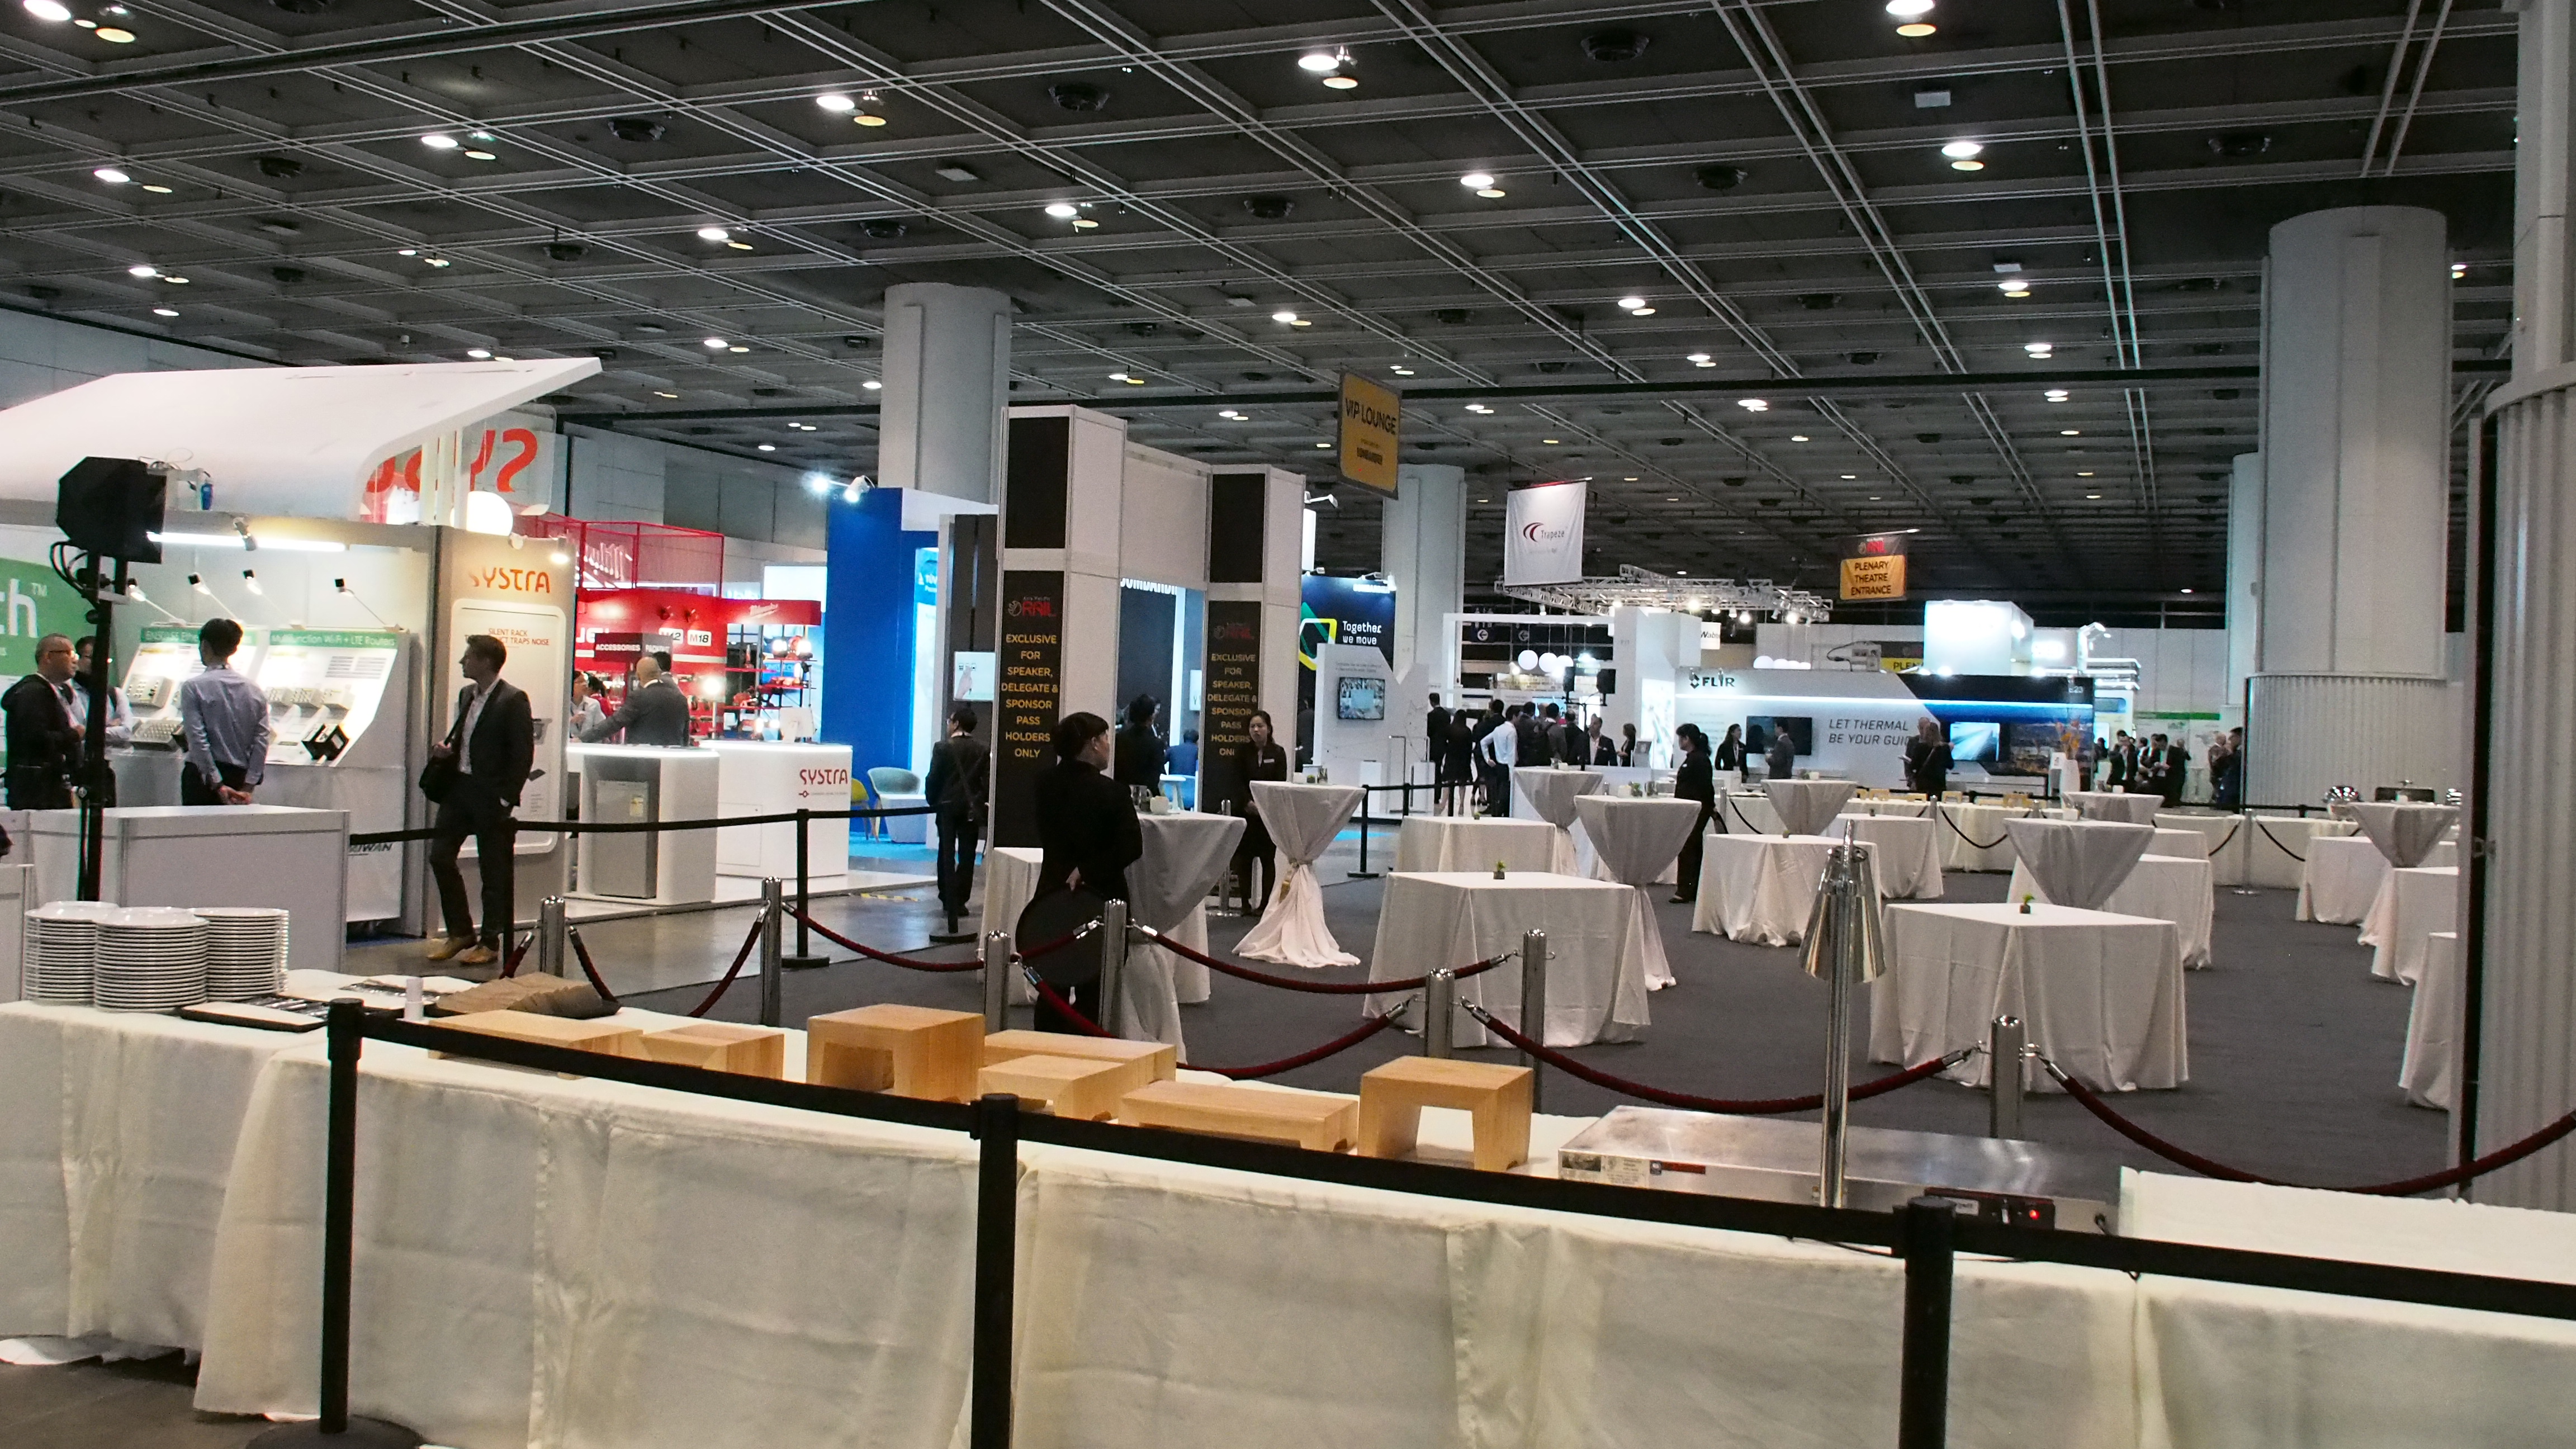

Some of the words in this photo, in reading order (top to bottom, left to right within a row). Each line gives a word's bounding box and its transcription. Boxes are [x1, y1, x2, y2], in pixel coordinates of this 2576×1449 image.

[1345, 398, 1360, 419] VIP
[1361, 404, 1396, 435] LOUNGE
[1541, 529, 1565, 541] Trapeze
[1854, 561, 1889, 571] PLENARY
[468, 567, 551, 594] SYSTRA
[1854, 573, 1888, 583] THEATRE
[1850, 585, 1892, 595] ENTRANCE
[1342, 621, 1382, 634] Together
[351, 635, 363, 645] LTE
[510, 637, 530, 645] TRAPS
[689, 634, 709, 643] M18
[1006, 634, 1057, 644] EXCLUSIVE
[1343, 635, 1354, 643] we
[1356, 636, 1377, 645] move
[1021, 650, 1040, 660] FOR
[1211, 653, 1256, 662] EXCLUSIVE
[1007, 666, 1053, 678] SPEAKER,
[1224, 667, 1242, 675] FOR
[1213, 680, 1252, 690] SPEAKER,
[1702, 676, 1735, 687] FLIR
[1001, 682, 1050, 693] DELEGATE
[1052, 684, 1058, 693] &
[1208, 694, 1249, 703] DELEGATE
[1006, 699, 1053, 709] SPONSOR
[1211, 707, 1252, 716] SPONSOR
[1016, 715, 1040, 726] PASS
[1221, 721, 1242, 729] PASS
[1829, 719, 1850, 729] LET
[1854, 719, 1909, 731] THERMAL
[1006, 731, 1051, 742] HOLDERS
[1211, 734, 1251, 743] HOLDERS
[1828, 733, 1844, 744] BE
[1848, 734, 1879, 745] YOUR
[1015, 748, 1041, 758] ONLY
[799, 769, 848, 784] SYSTRA
